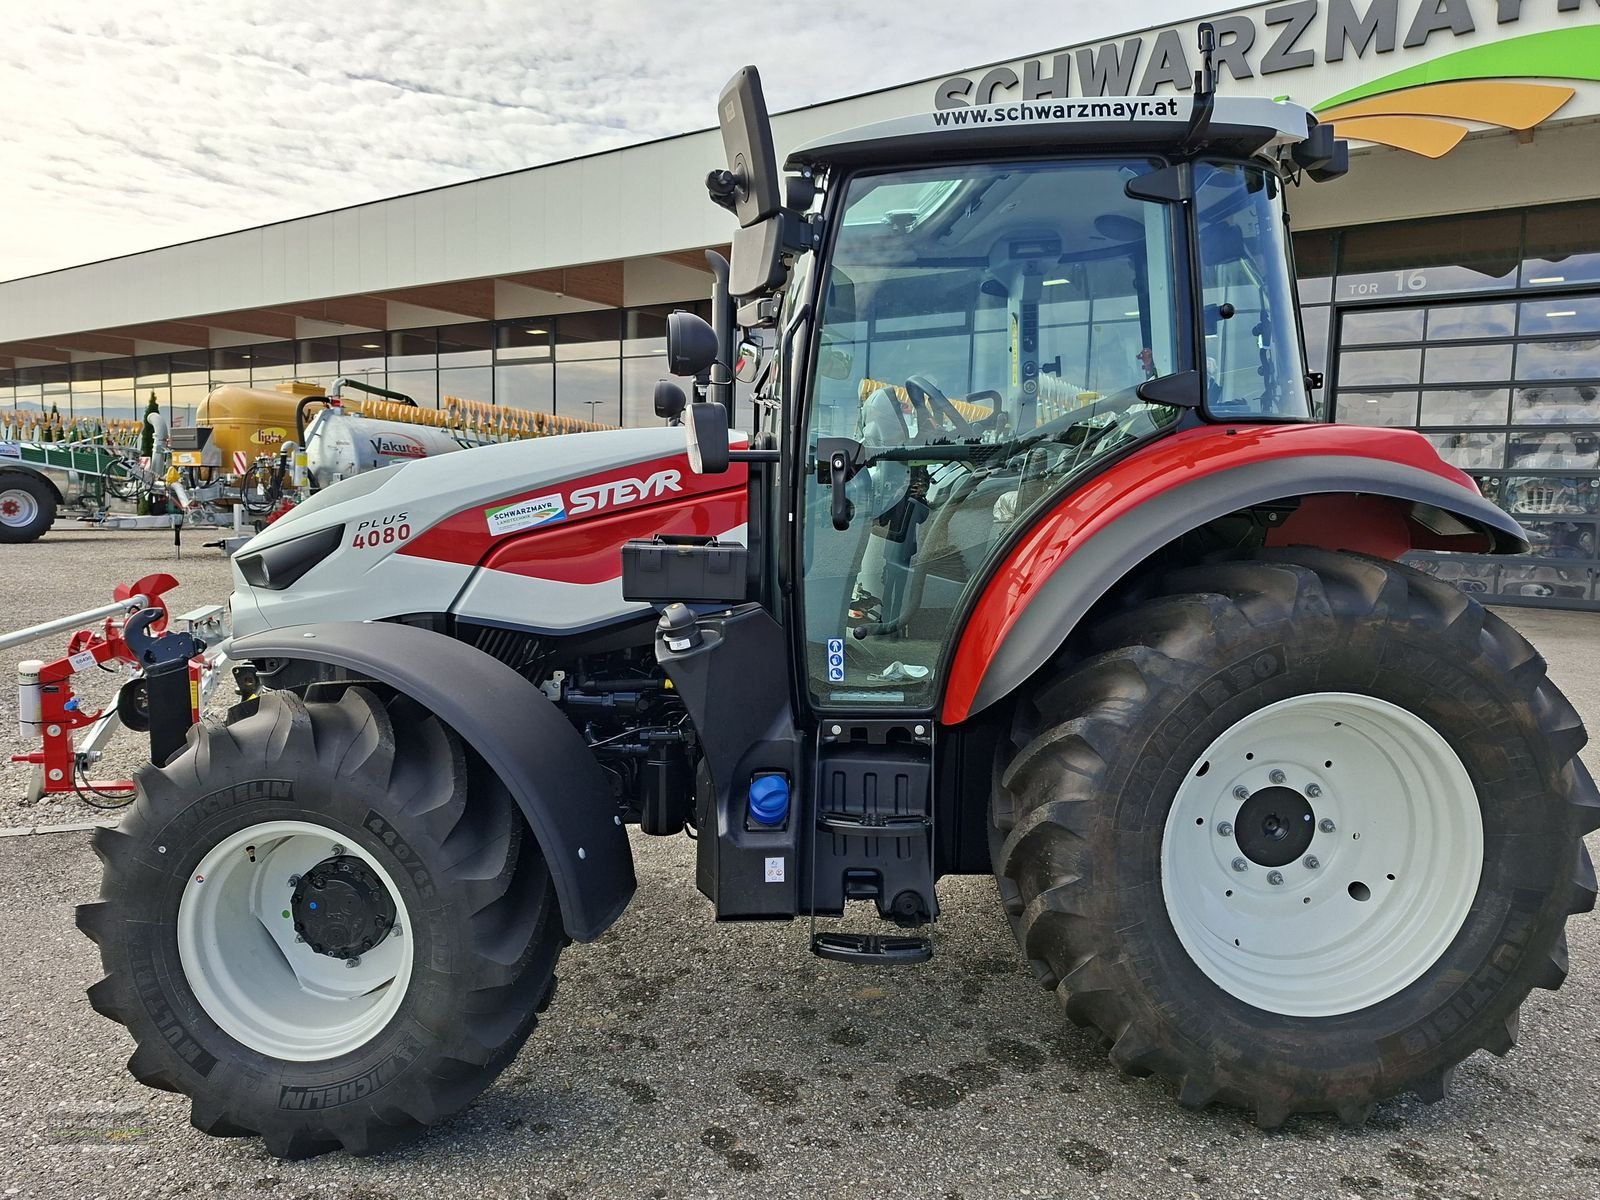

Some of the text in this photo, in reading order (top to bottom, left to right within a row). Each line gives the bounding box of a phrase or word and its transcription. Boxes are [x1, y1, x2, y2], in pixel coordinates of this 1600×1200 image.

[934, 0, 1600, 111] SCHWARZMA
[933, 98, 1178, 126] www.schwarzmayr.at
[1348, 268, 1427, 295] TOR 16
[370, 437, 427, 455] Vakutec
[569, 469, 683, 515] STEYR
[357, 511, 409, 532] PLUS
[494, 502, 553, 521] SCHWARZMAYR
[352, 523, 411, 550] 4080
[280, 1057, 397, 1110] MICHELIN
